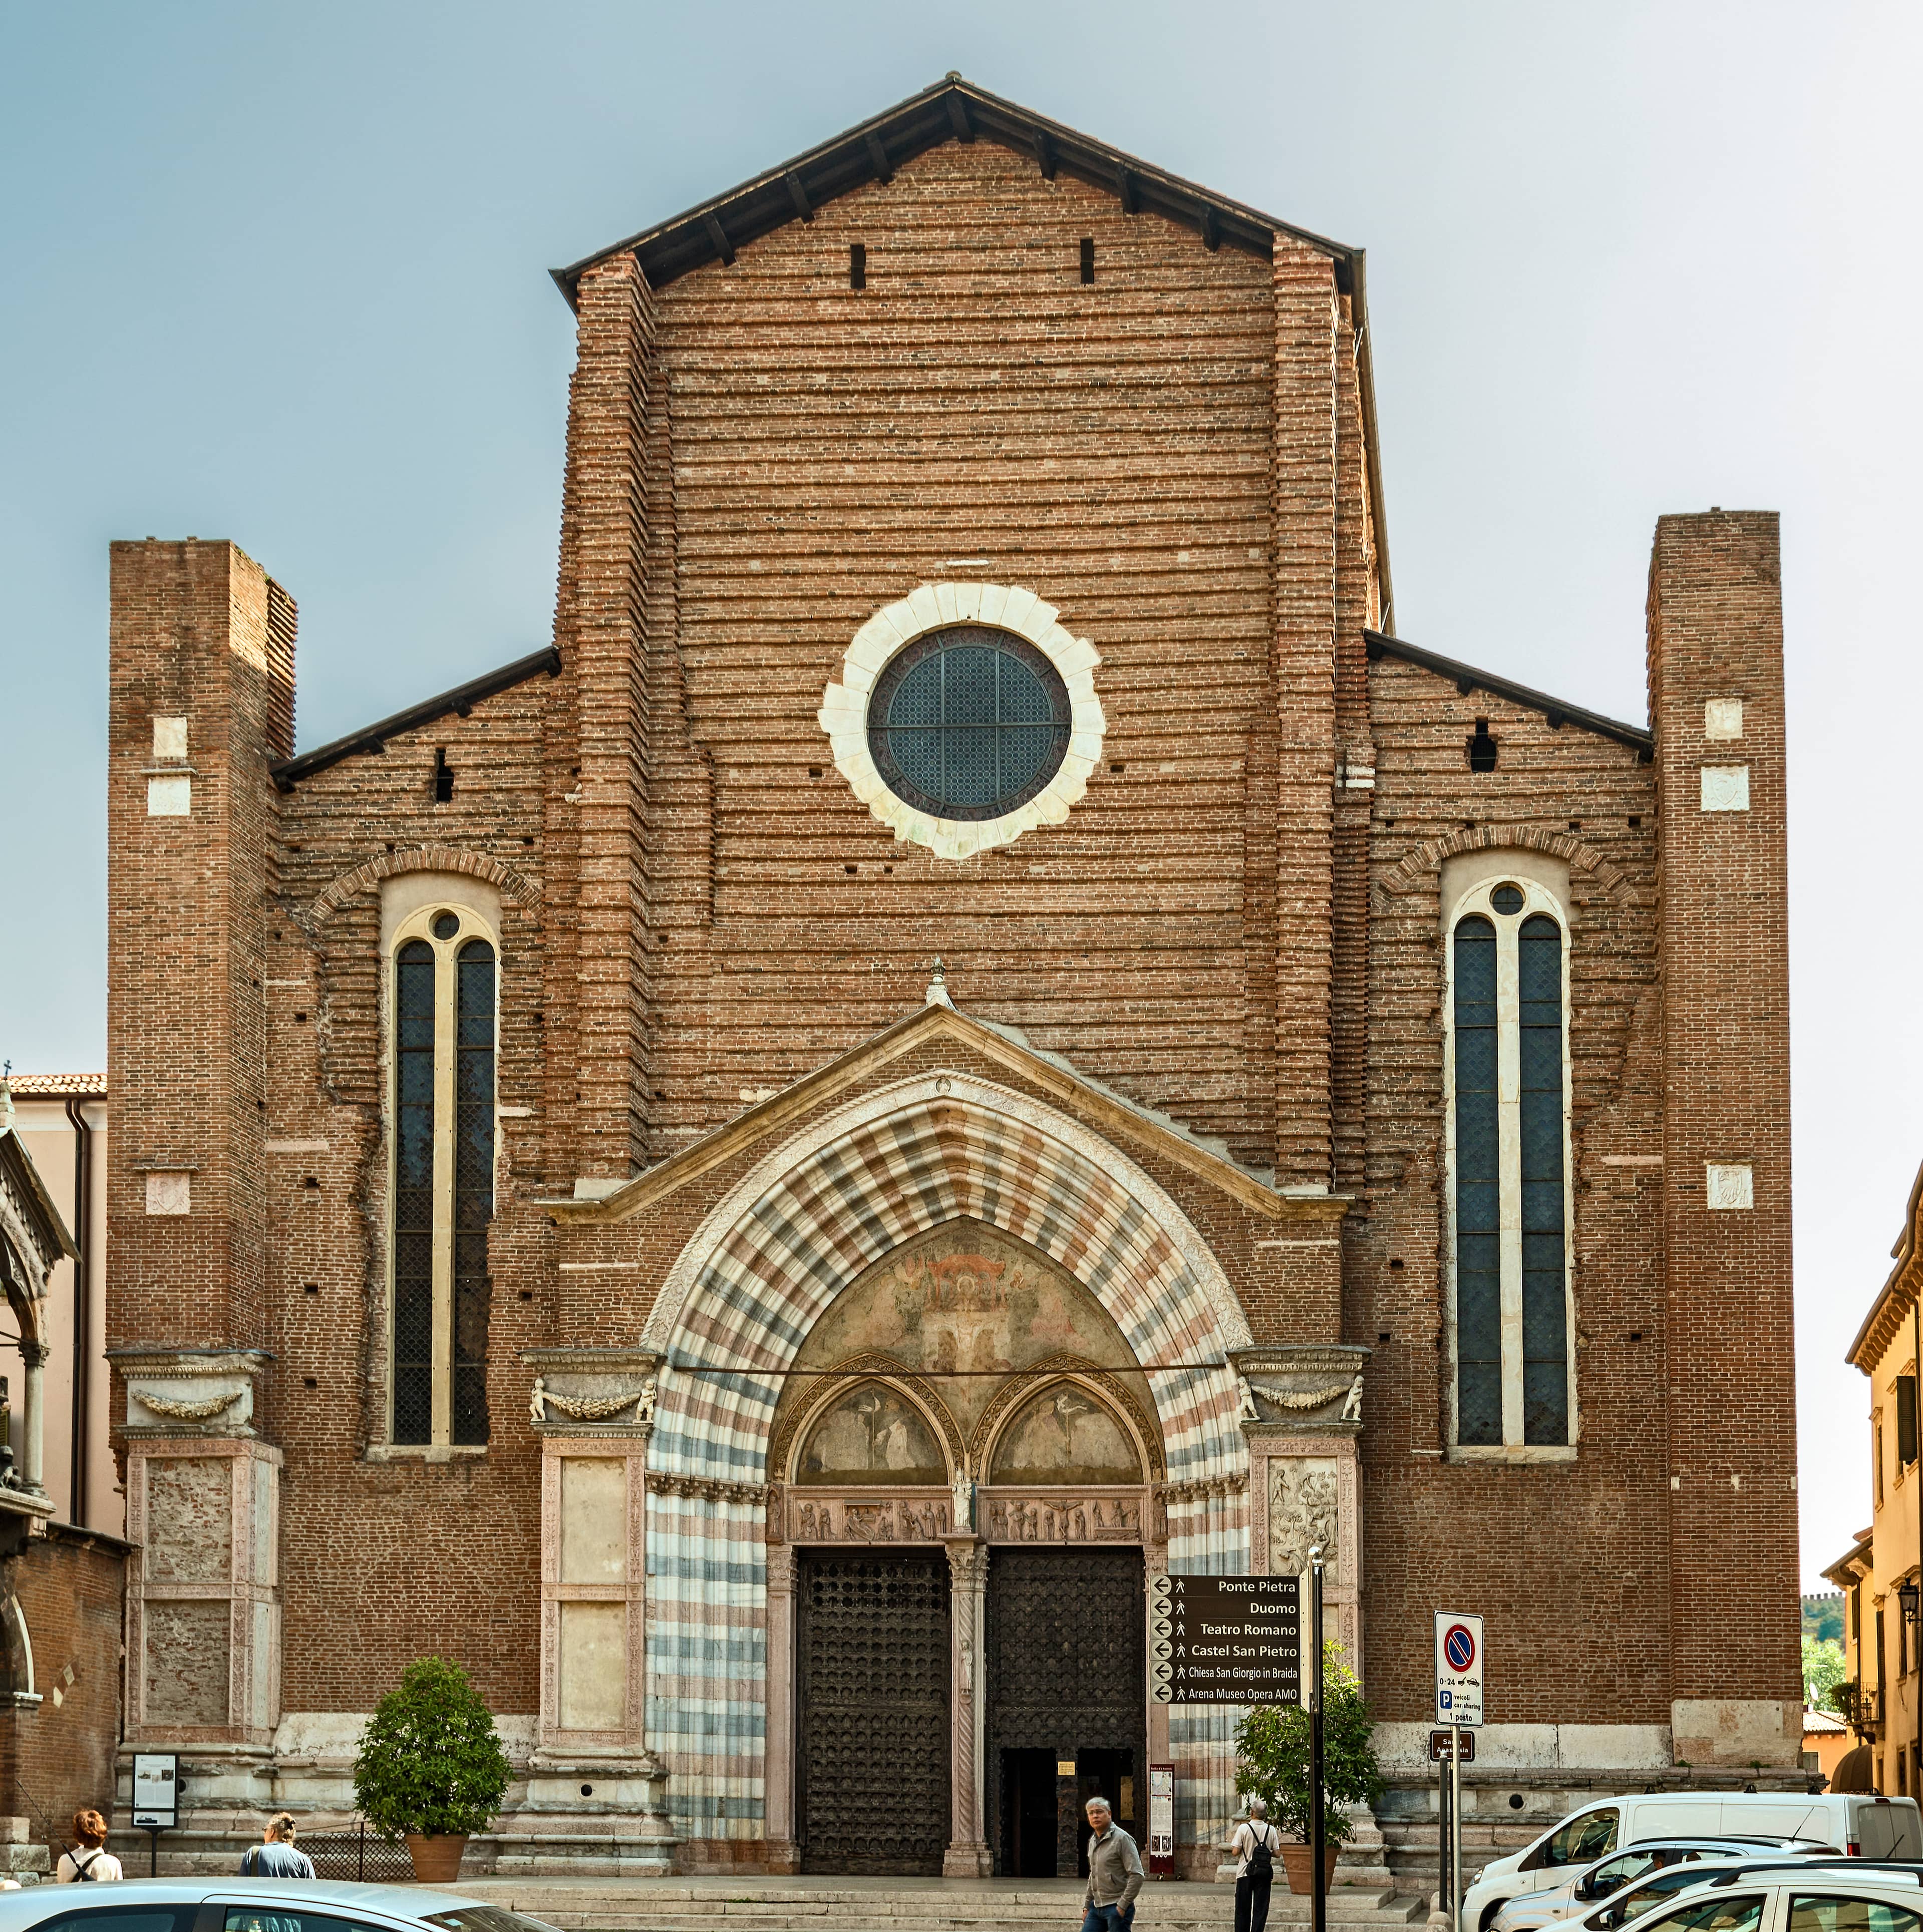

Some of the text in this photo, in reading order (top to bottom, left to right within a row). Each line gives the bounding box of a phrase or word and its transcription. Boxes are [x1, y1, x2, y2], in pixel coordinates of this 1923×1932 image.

[1218, 1581, 1296, 1592] Ponte Pietra
[1250, 1603, 1296, 1614] Duomo
[1200, 1624, 1296, 1635] Teatro Romano
[1192, 1645, 1297, 1657] Castel San Pietro
[1189, 1667, 1298, 1680] Chiesa San Giorgio in Braida
[1440, 1678, 1455, 1686] 0-24
[1189, 1688, 1297, 1702] Arena Museo Opera AMO
[1443, 1693, 1450, 1706] P
[1464, 1703, 1481, 1711] sharing
[1455, 1714, 1472, 1722] posto
